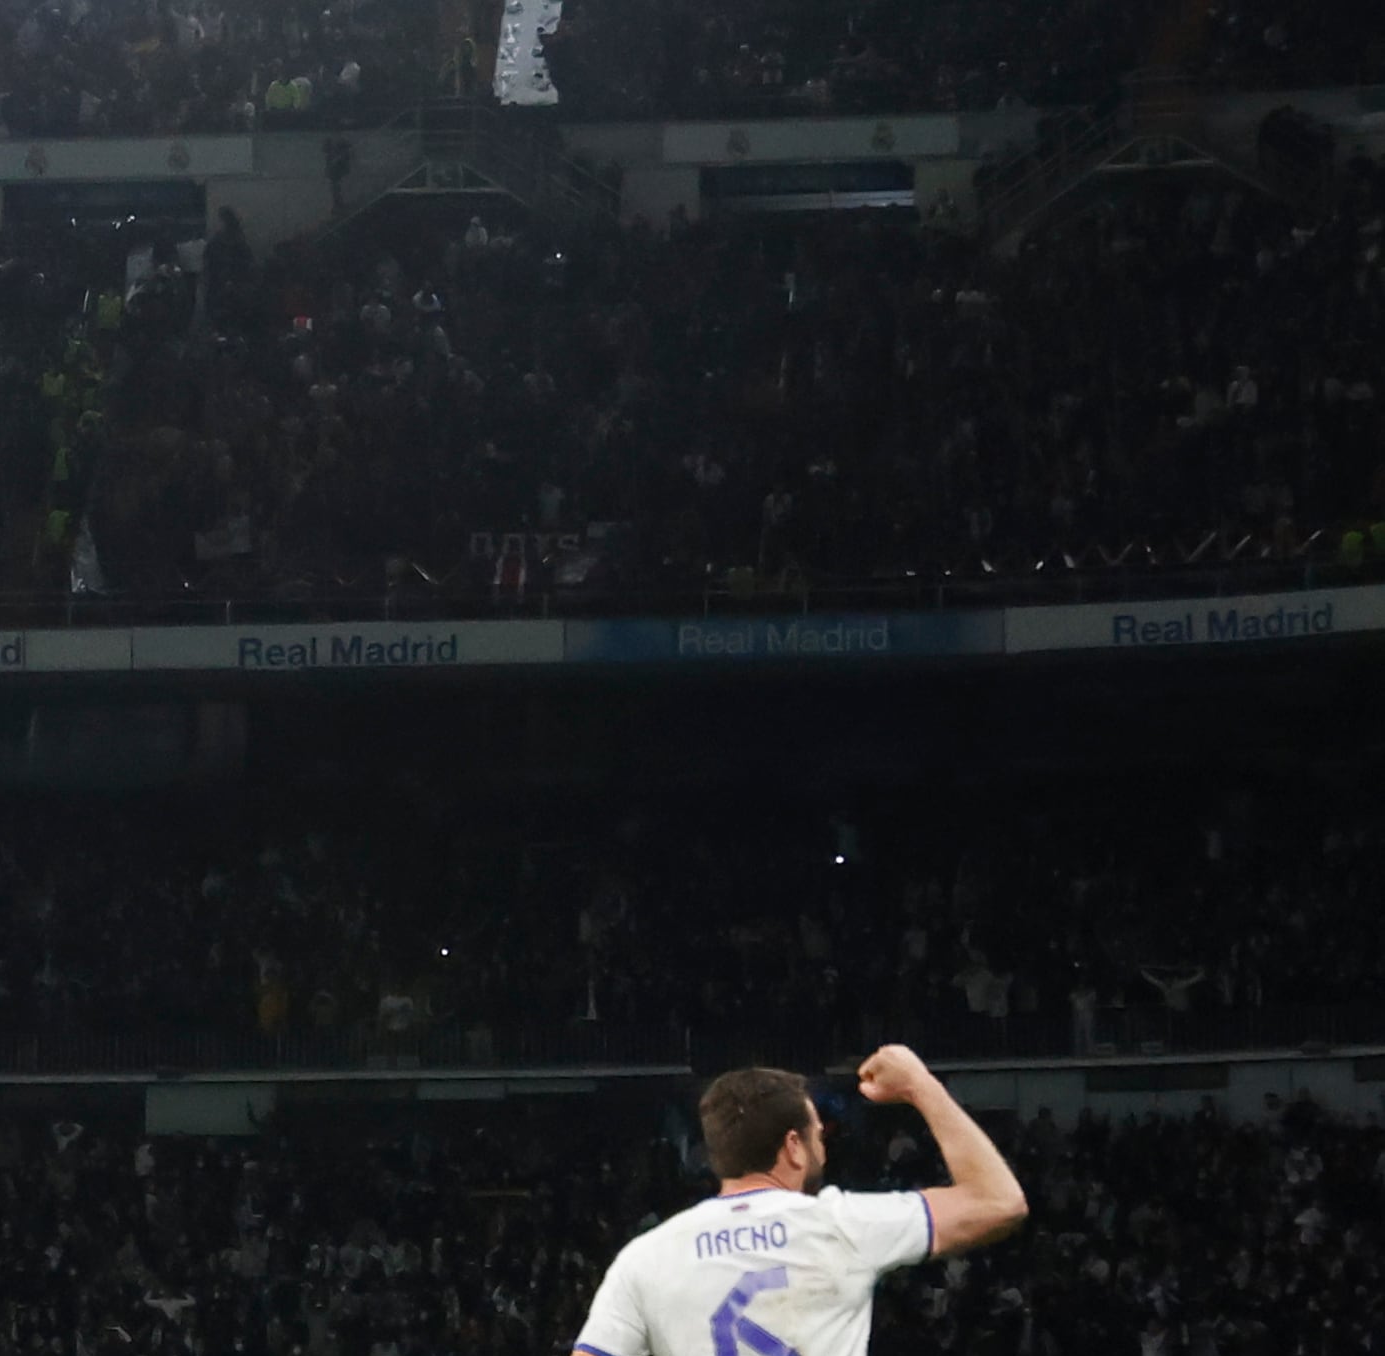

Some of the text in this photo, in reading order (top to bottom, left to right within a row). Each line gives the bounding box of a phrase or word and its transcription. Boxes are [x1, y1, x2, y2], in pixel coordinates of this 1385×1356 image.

[679, 620, 888, 654] Real Madrid
[1113, 603, 1333, 643] Real Madrid
[239, 634, 458, 666] Real Madrid
[696, 1221, 788, 1260] NACHO
